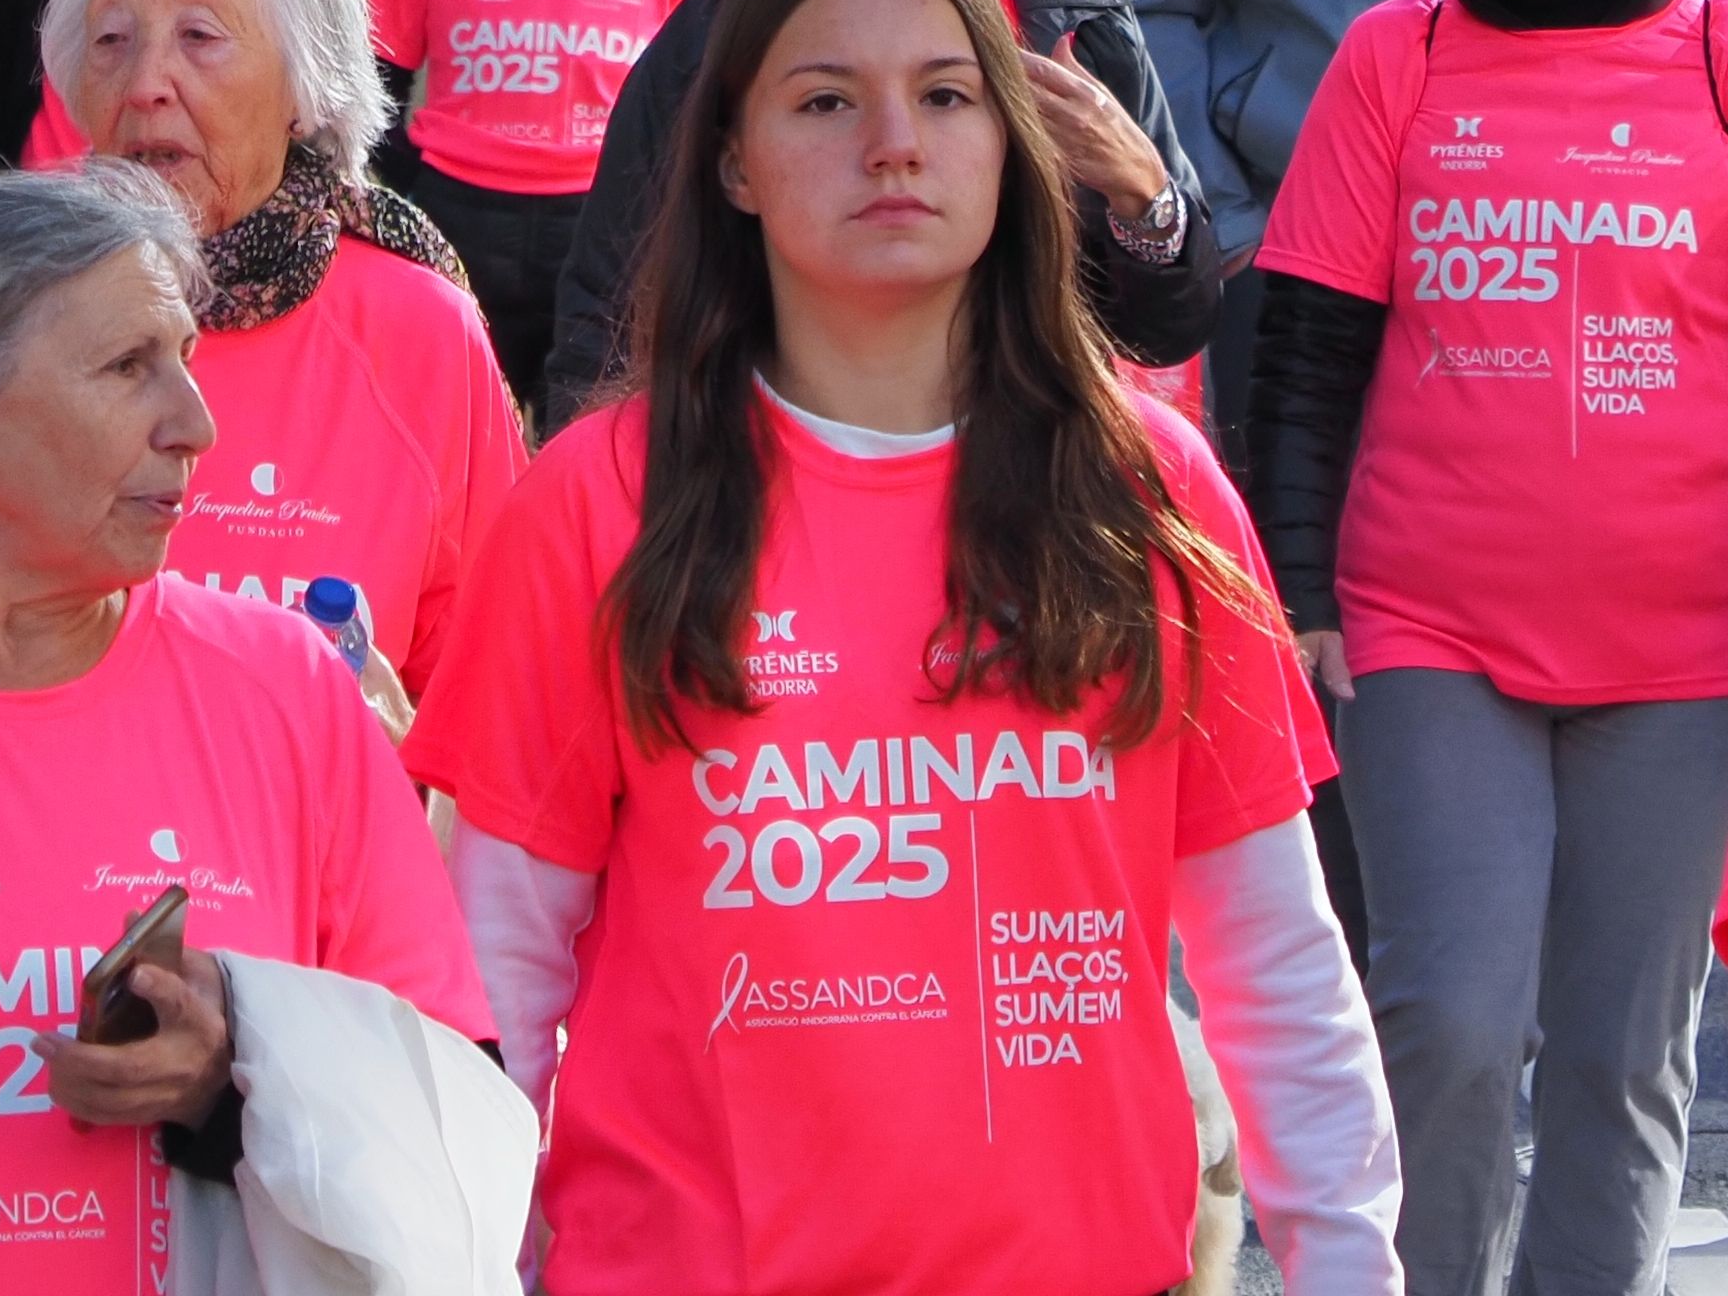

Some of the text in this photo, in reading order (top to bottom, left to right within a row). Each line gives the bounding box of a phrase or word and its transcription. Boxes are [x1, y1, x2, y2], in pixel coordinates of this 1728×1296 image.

[451, 54, 561, 94] 2025
[1430, 143, 1504, 159] PYRÉNÉES
[1409, 199, 1699, 253] CAMINADA
[1410, 246, 1560, 301] 2025
[1583, 315, 1673, 338] SUMEM
[1582, 366, 1676, 389] SUMEM
[1582, 392, 1645, 416] VIDA
[183, 491, 273, 522] Jacqueline
[227, 524, 305, 538] FUNDACIÓ
[746, 678, 818, 697] NDORRA
[691, 730, 1115, 816] CAMINADA
[702, 813, 950, 909] 2025
[990, 910, 1125, 945] SUMEM
[992, 950, 1129, 989] LLAÇOS,
[743, 972, 946, 1012] ASSANDCA
[995, 990, 1122, 1027] SUMEM
[996, 1033, 1083, 1068] VIDA
